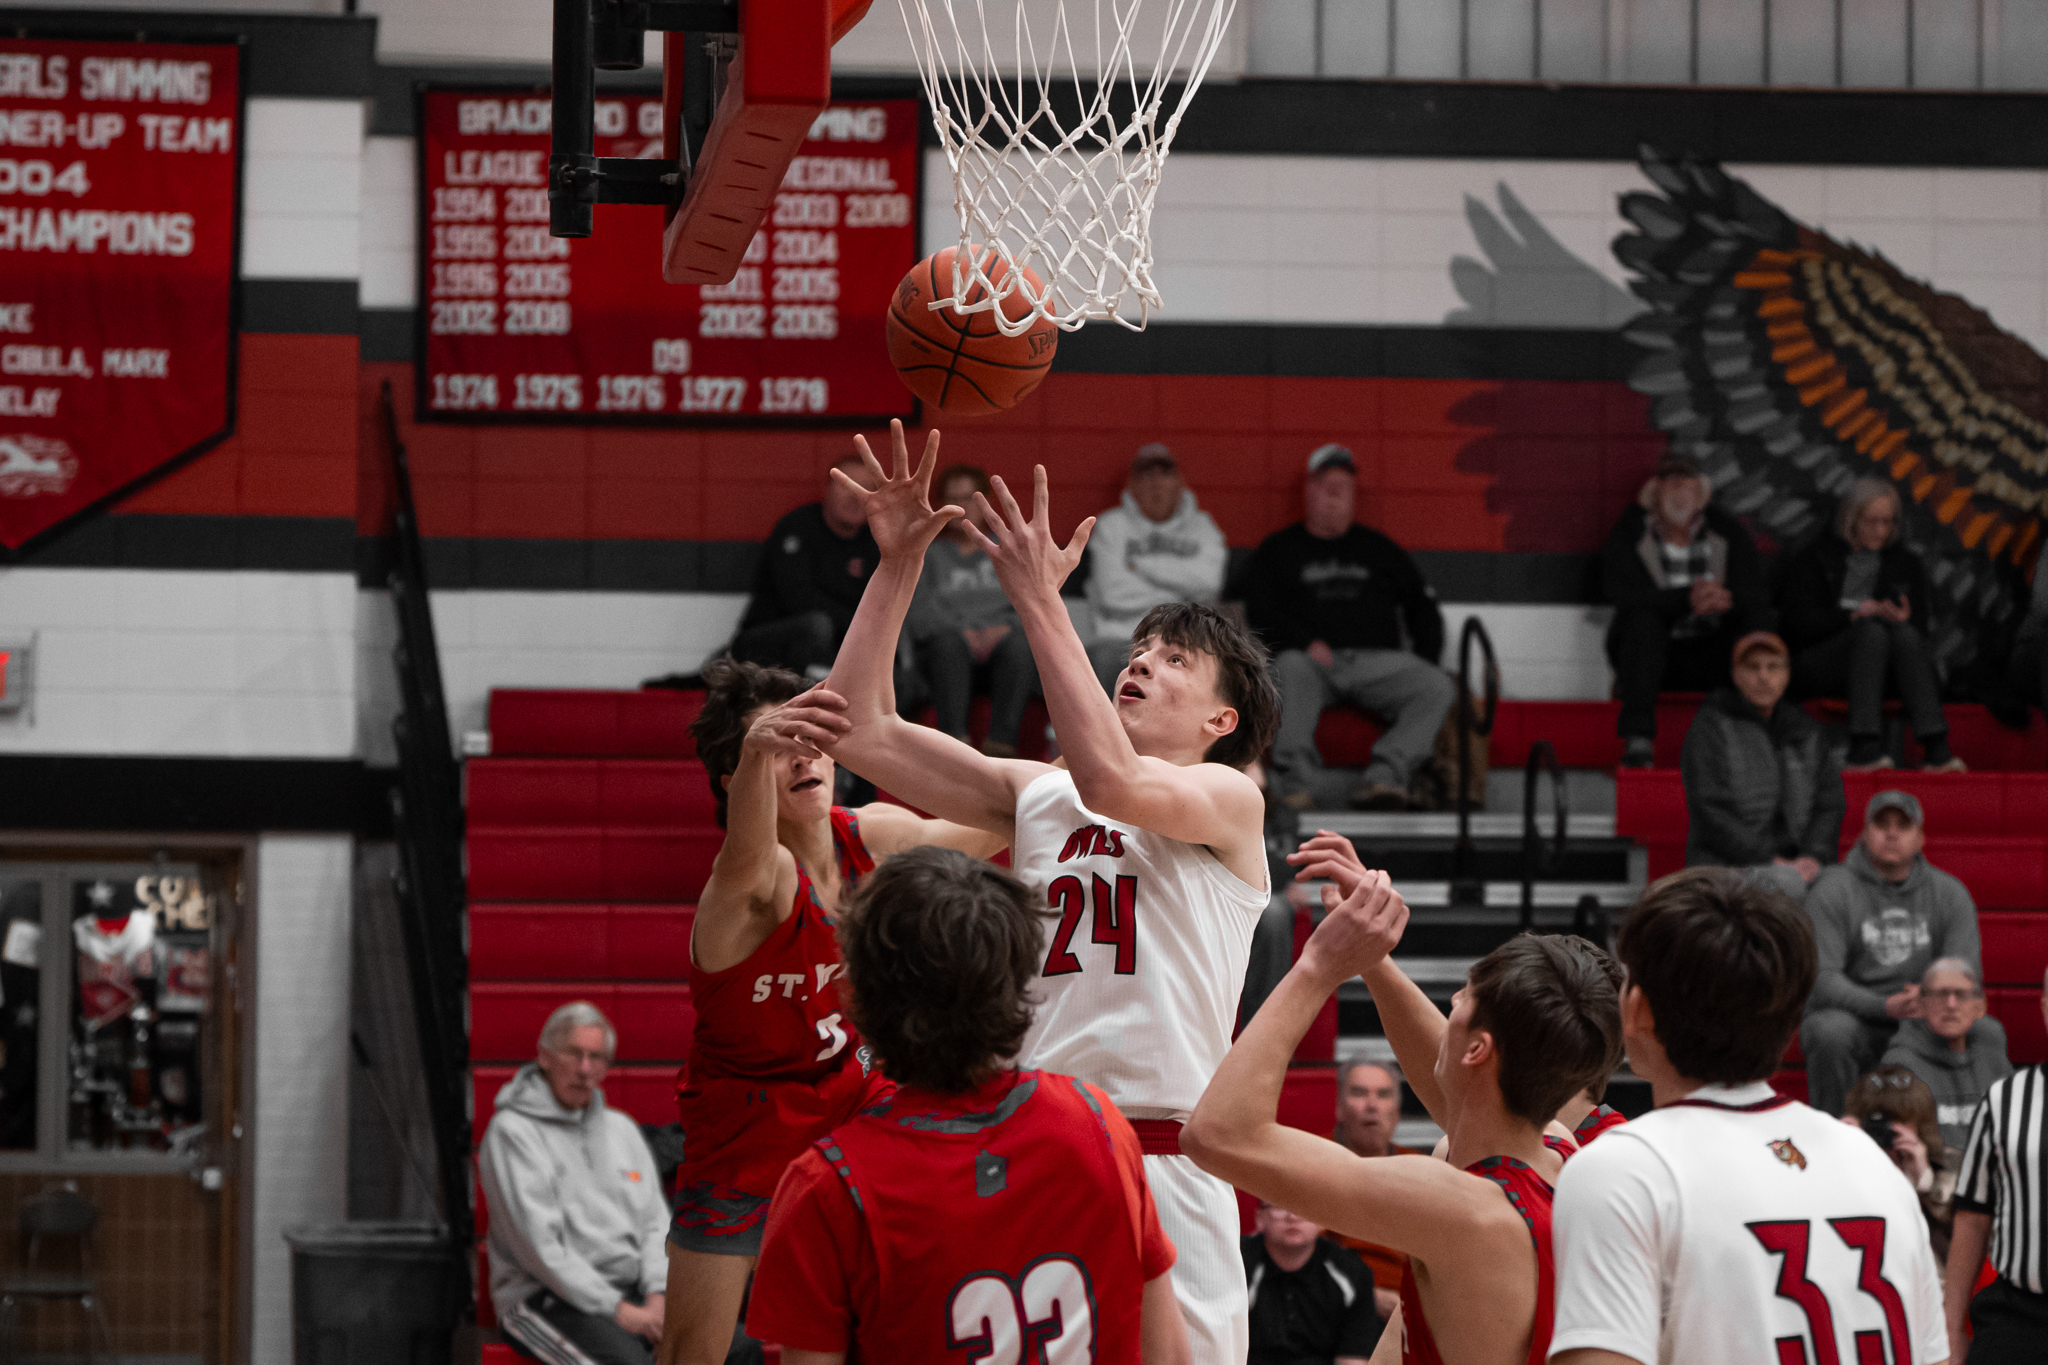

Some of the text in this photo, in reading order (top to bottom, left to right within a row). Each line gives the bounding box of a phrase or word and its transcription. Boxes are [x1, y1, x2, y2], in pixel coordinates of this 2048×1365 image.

[81, 57, 211, 105] SWIMMING
[138, 114, 232, 153] TEAM
[444, 150, 545, 185] LEAGUE
[433, 187, 549, 222] 1994 200
[433, 224, 498, 259] 1995
[772, 229, 839, 264] 2004
[433, 262, 571, 297] 1996 2005
[772, 267, 840, 301] 2005
[432, 300, 498, 335] 2002
[699, 303, 766, 338] 2002
[433, 373, 499, 410] 1974
[513, 373, 583, 410] 1975
[597, 375, 666, 411] 1976
[679, 376, 747, 412] 1977
[1057, 823, 1128, 863] OWLS
[1042, 871, 1138, 978] 24
[752, 973, 808, 1003] ST.
[1744, 1216, 1914, 1365] 33
